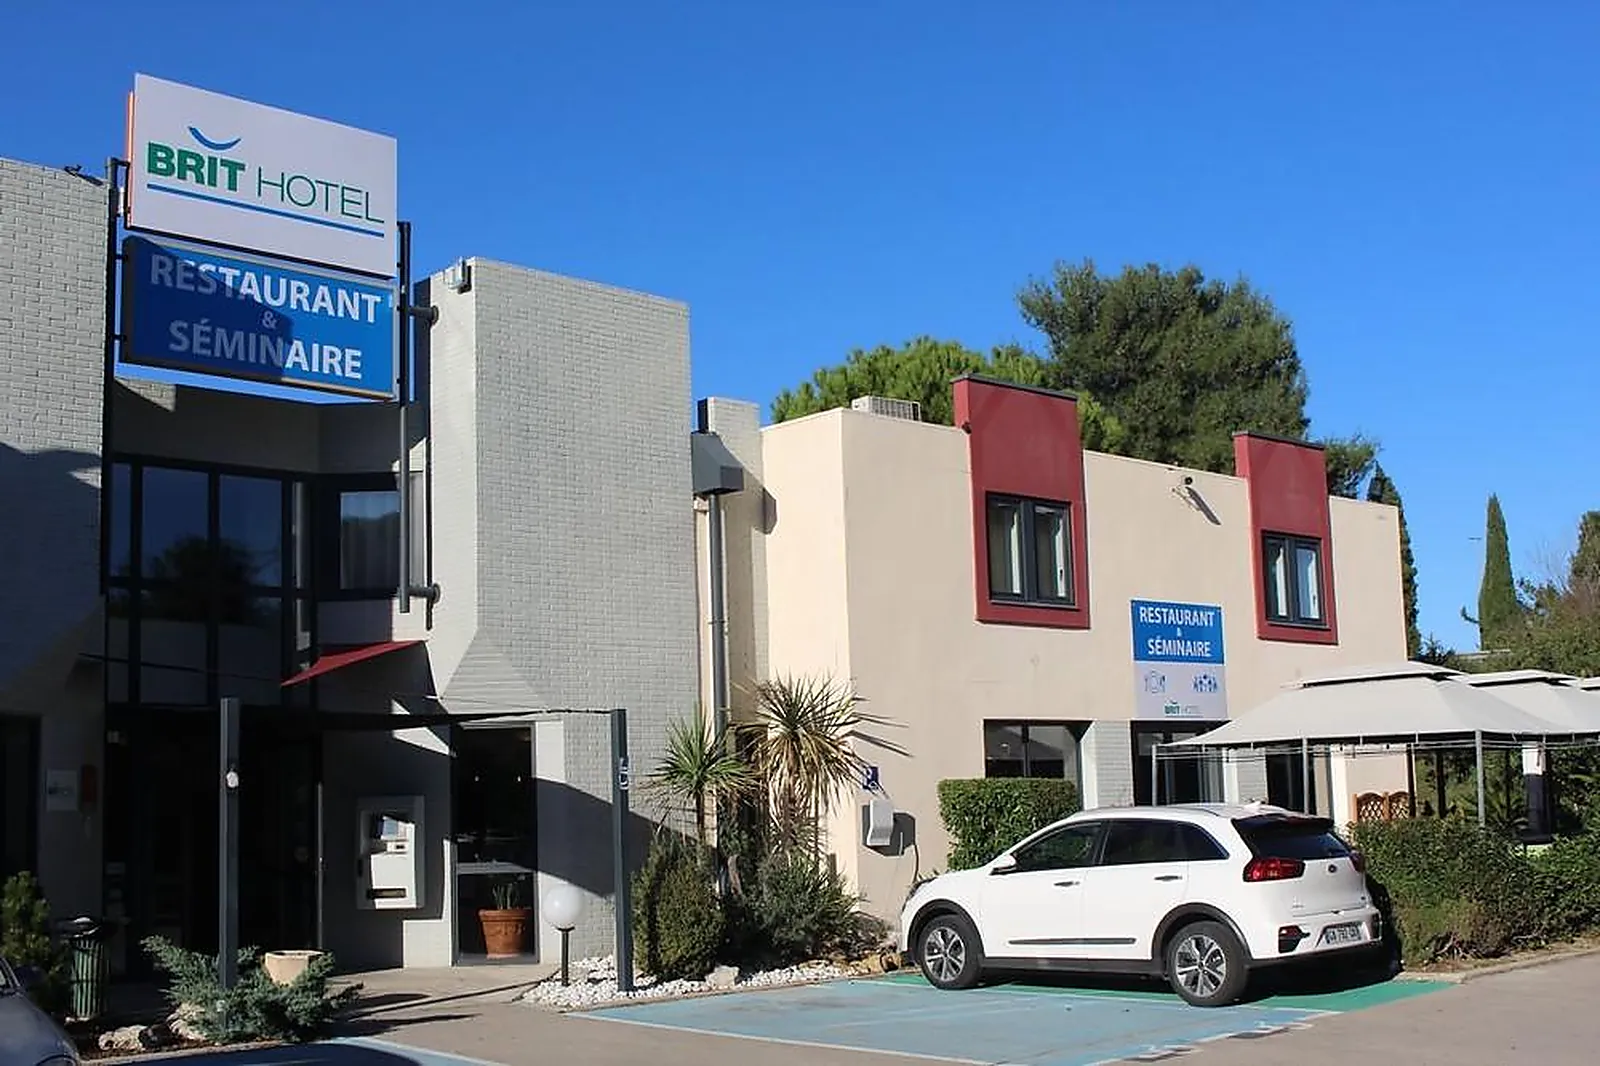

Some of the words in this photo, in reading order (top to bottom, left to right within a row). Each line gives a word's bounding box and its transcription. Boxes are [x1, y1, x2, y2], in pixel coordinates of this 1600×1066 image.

[147, 141, 245, 192] BRIT
[258, 166, 385, 224] HOTEL
[151, 254, 381, 323] RESTAURANT
[262, 311, 278, 329] &
[168, 319, 362, 379] SÉMINAIRE
[1139, 606, 1215, 627] RESTAURANT
[1147, 635, 1212, 657] SÉMINAIRE
